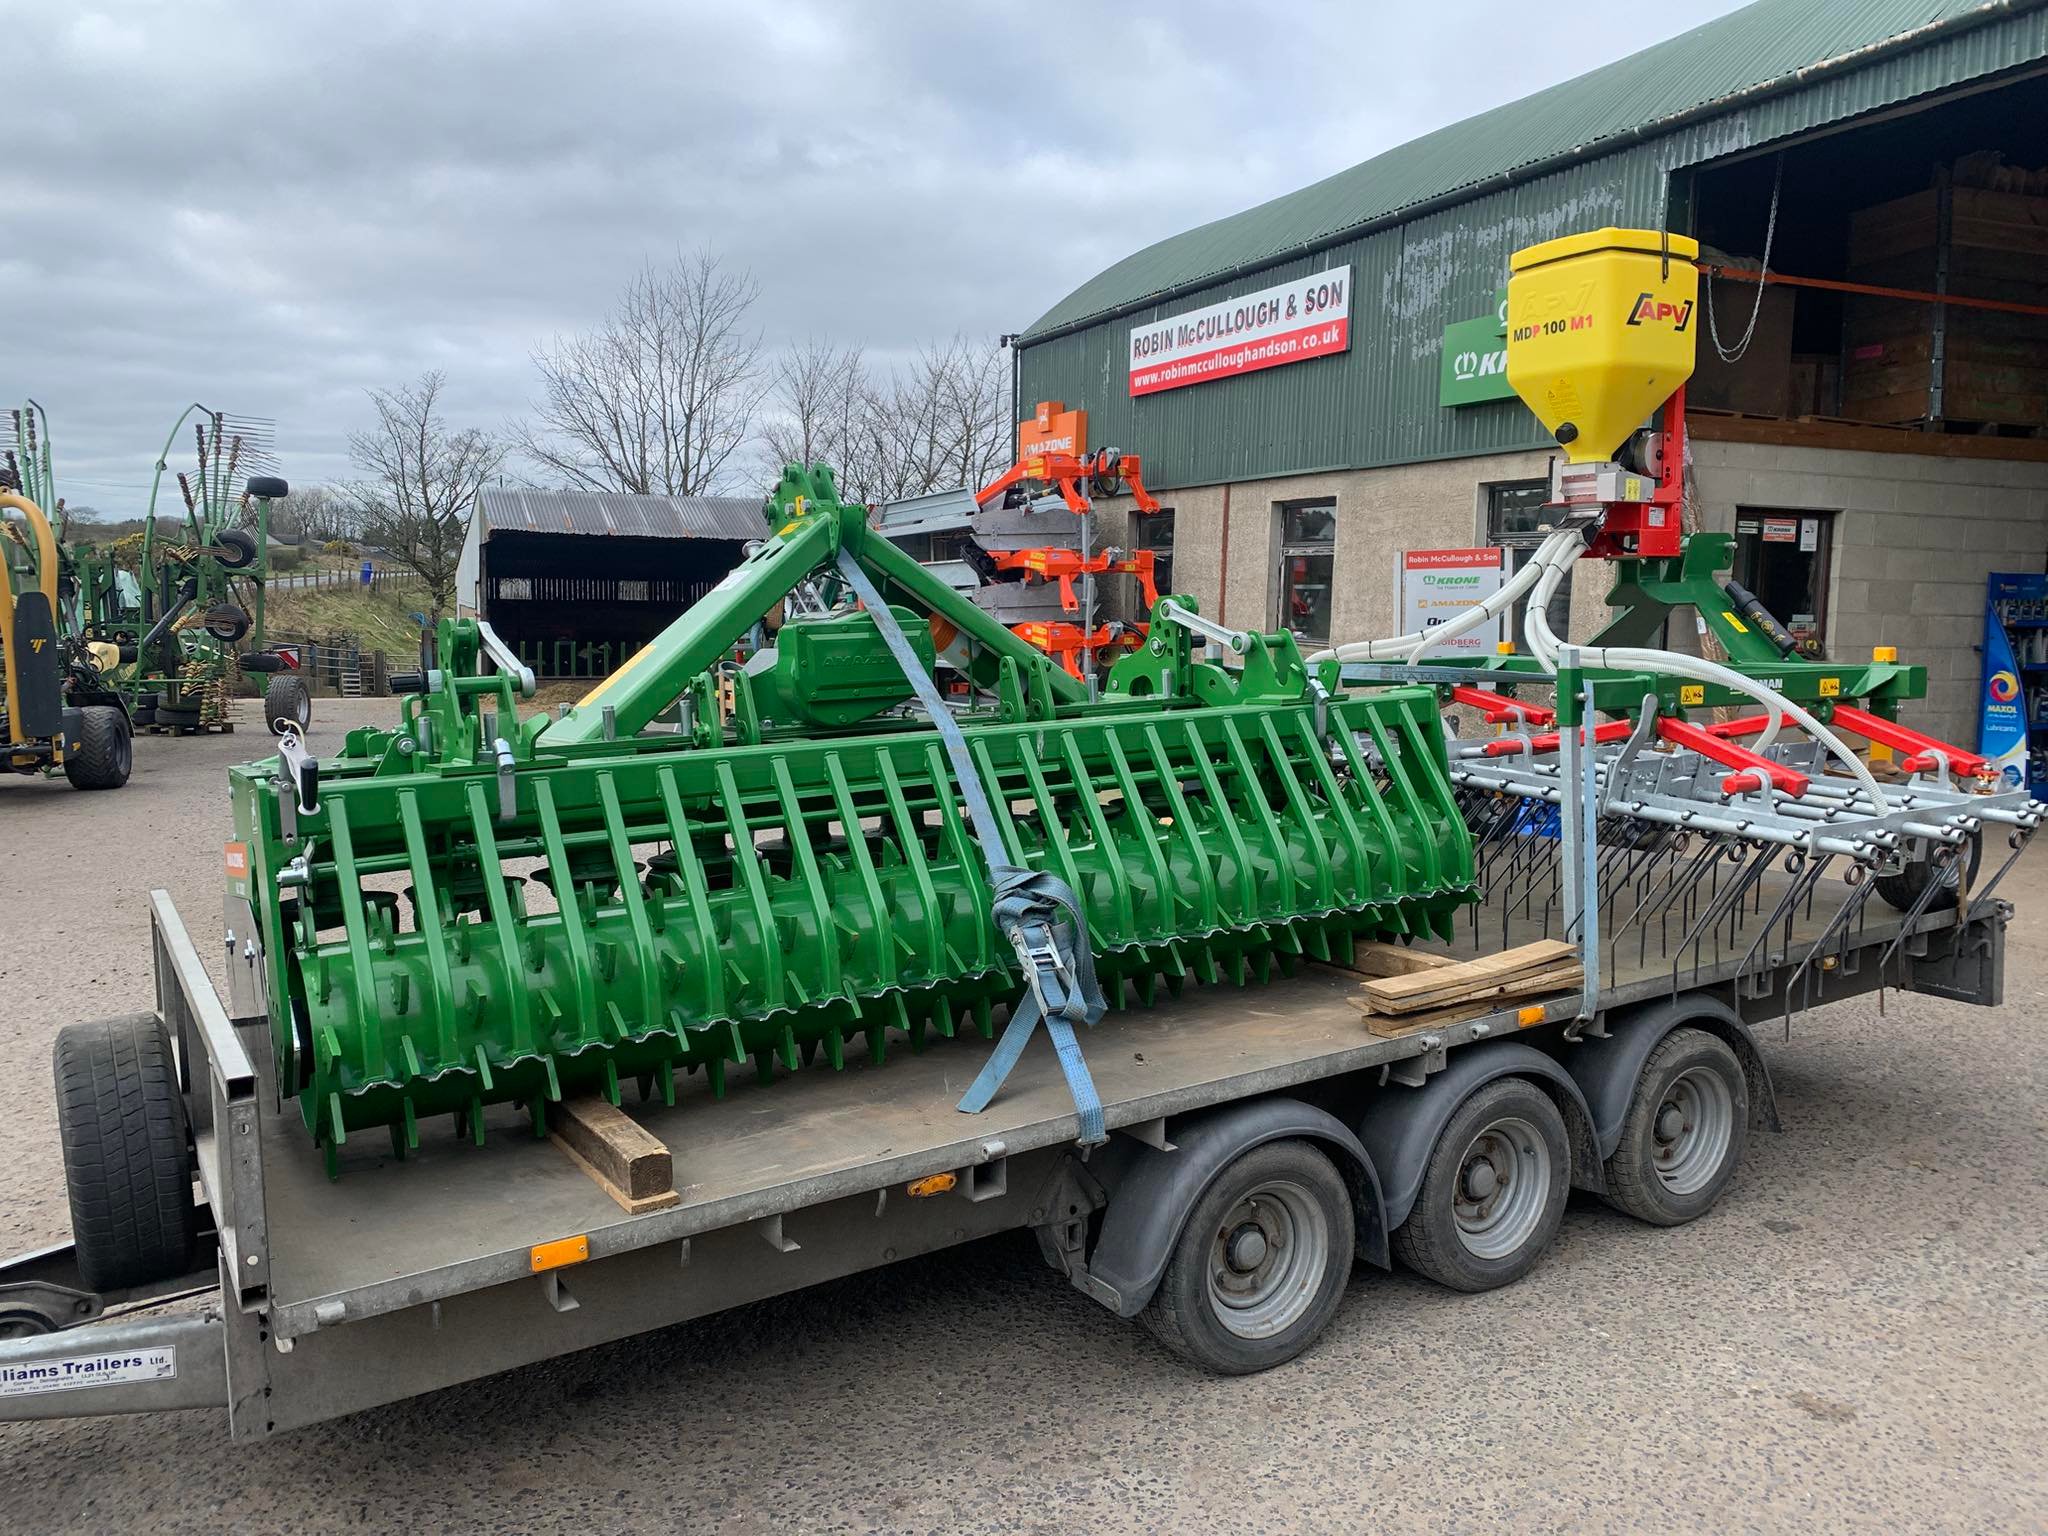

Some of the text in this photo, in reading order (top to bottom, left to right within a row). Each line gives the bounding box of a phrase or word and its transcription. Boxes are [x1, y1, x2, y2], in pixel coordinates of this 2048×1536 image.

[1134, 280, 1344, 358] ROBIN McCULLOUGH & SON
[1513, 314, 1593, 343] MDP 100 M1
[1134, 325, 1340, 388] www.robinmcculloughandson.co.uk
[1431, 554, 1473, 563] McCullough
[1475, 553, 1481, 561] &
[1483, 553, 1498, 561] Son
[1436, 576, 1480, 585] KRONE
[1987, 705, 2017, 714] MAXOL
[0, 1366, 59, 1381] liams
[62, 1357, 143, 1375] Trailers
[150, 1356, 168, 1366] Ltd.
